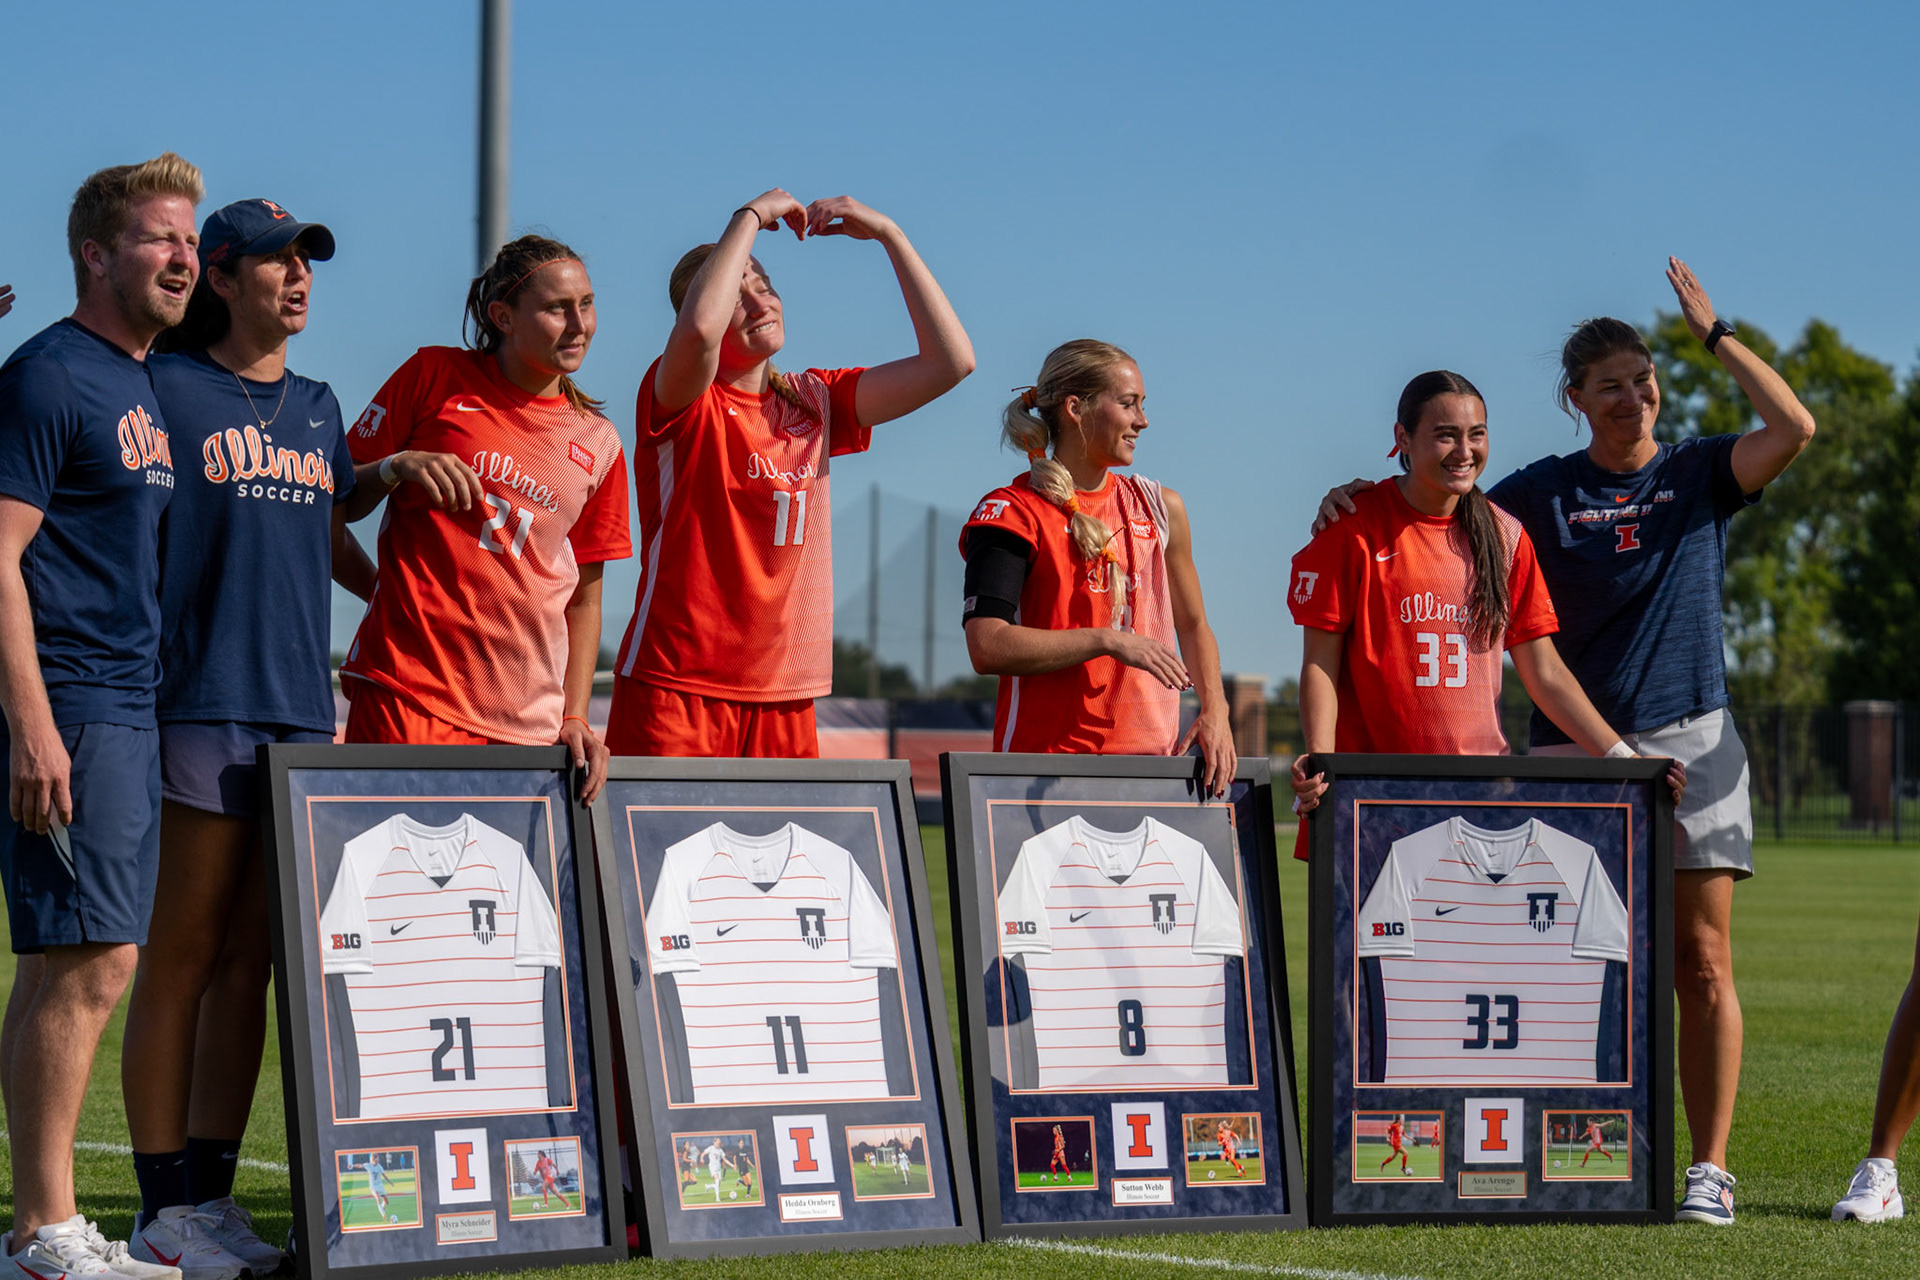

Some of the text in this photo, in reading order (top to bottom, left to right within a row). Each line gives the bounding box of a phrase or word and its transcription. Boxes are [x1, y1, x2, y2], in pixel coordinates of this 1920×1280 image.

[118, 404, 174, 471] Illin
[202, 425, 335, 495] Illinois
[237, 484, 316, 505] SOCCER
[471, 450, 560, 513] Illinois
[478, 492, 535, 561] 21
[773, 490, 807, 547] 11
[1568, 505, 1640, 524] FIGHTING
[1615, 523, 1641, 553] I
[1400, 591, 1474, 624] Illino
[1415, 632, 1468, 688] 33
[766, 1015, 809, 1075] 11
[1118, 999, 1147, 1057] 8
[1462, 994, 1519, 1050] 33
[429, 1017, 476, 1082] 21
[788, 1127, 819, 1172] I
[1126, 1113, 1153, 1158] I
[1480, 1108, 1508, 1151] I
[449, 1141, 476, 1191] I
[1121, 1182, 1164, 1192] Sutton Webb
[1472, 1176, 1515, 1185] Ava Arengo
[441, 1218, 491, 1230] Myra Schneider
[785, 1198, 836, 1208] Hedda Ornberg
